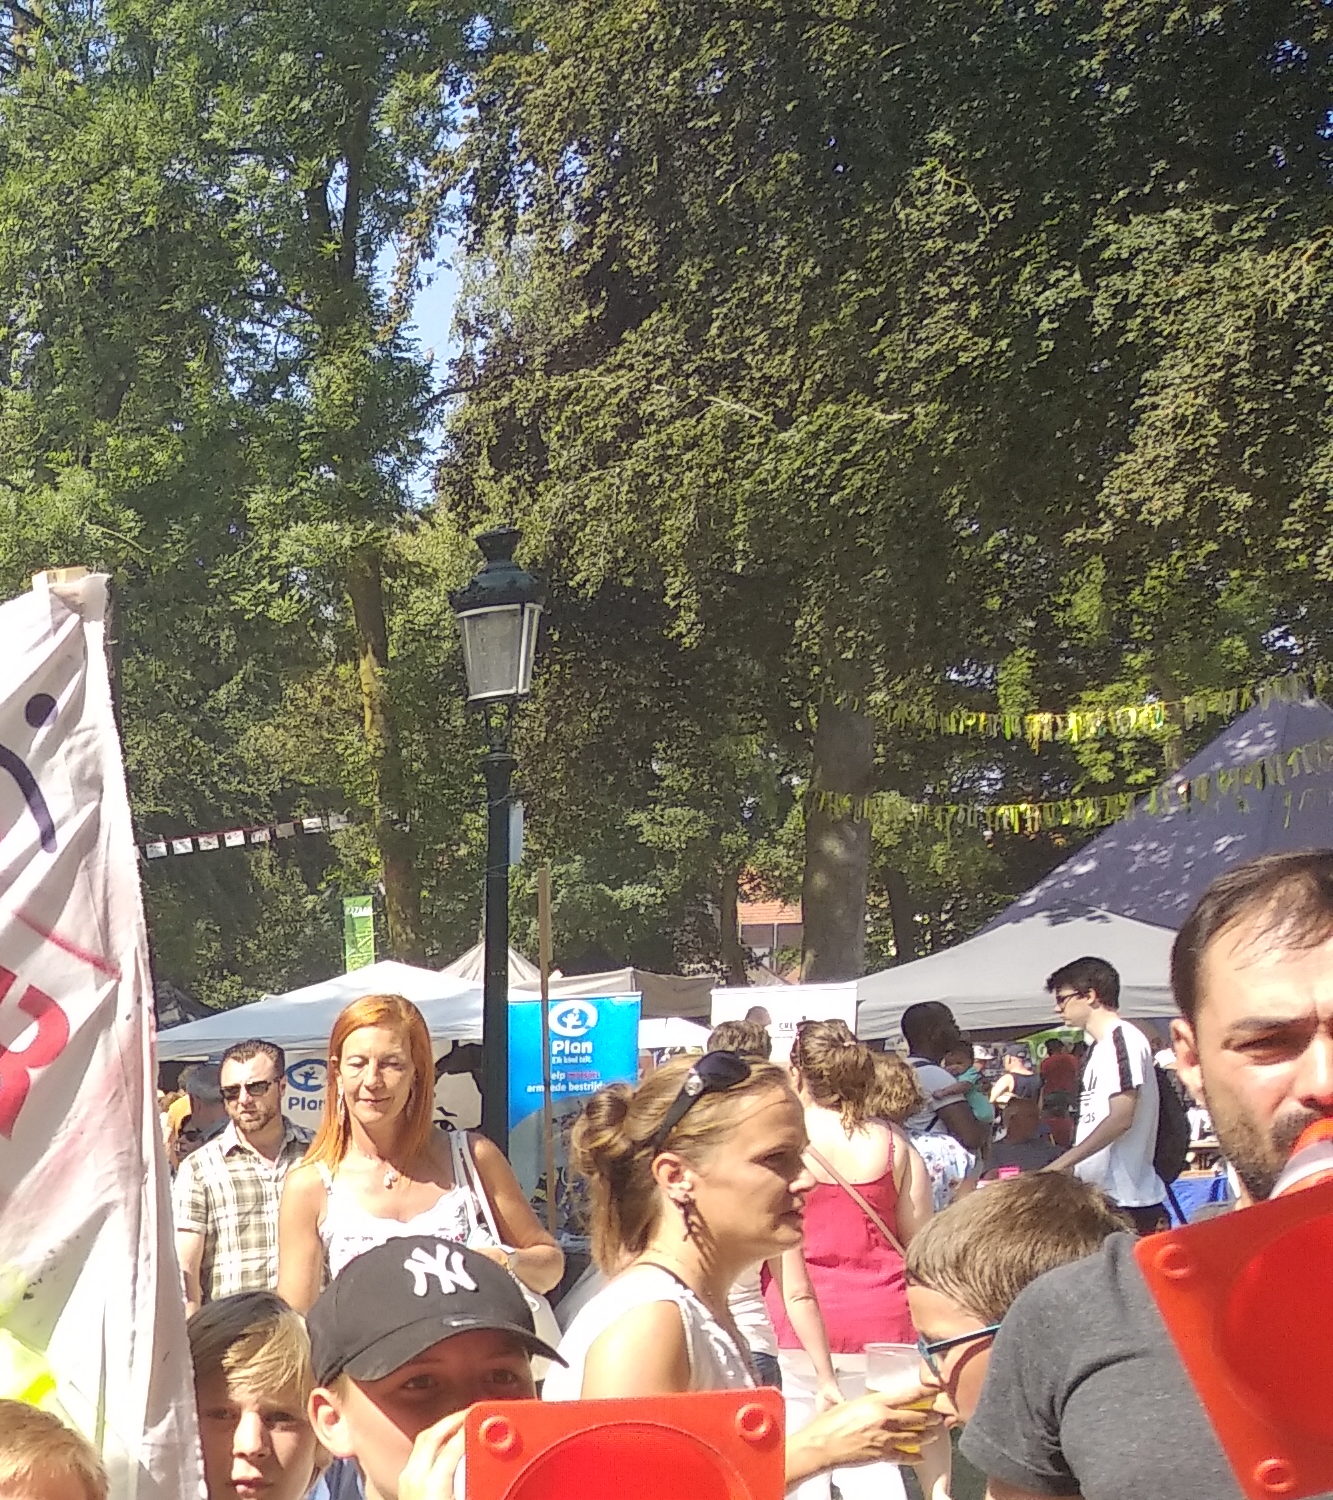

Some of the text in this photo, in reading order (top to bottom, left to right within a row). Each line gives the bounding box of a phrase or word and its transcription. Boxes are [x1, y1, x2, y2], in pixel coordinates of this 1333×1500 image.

[552, 1040, 593, 1055] Plan
[551, 1070, 566, 1081] elp
[527, 1080, 603, 1092] armede bestrijd
